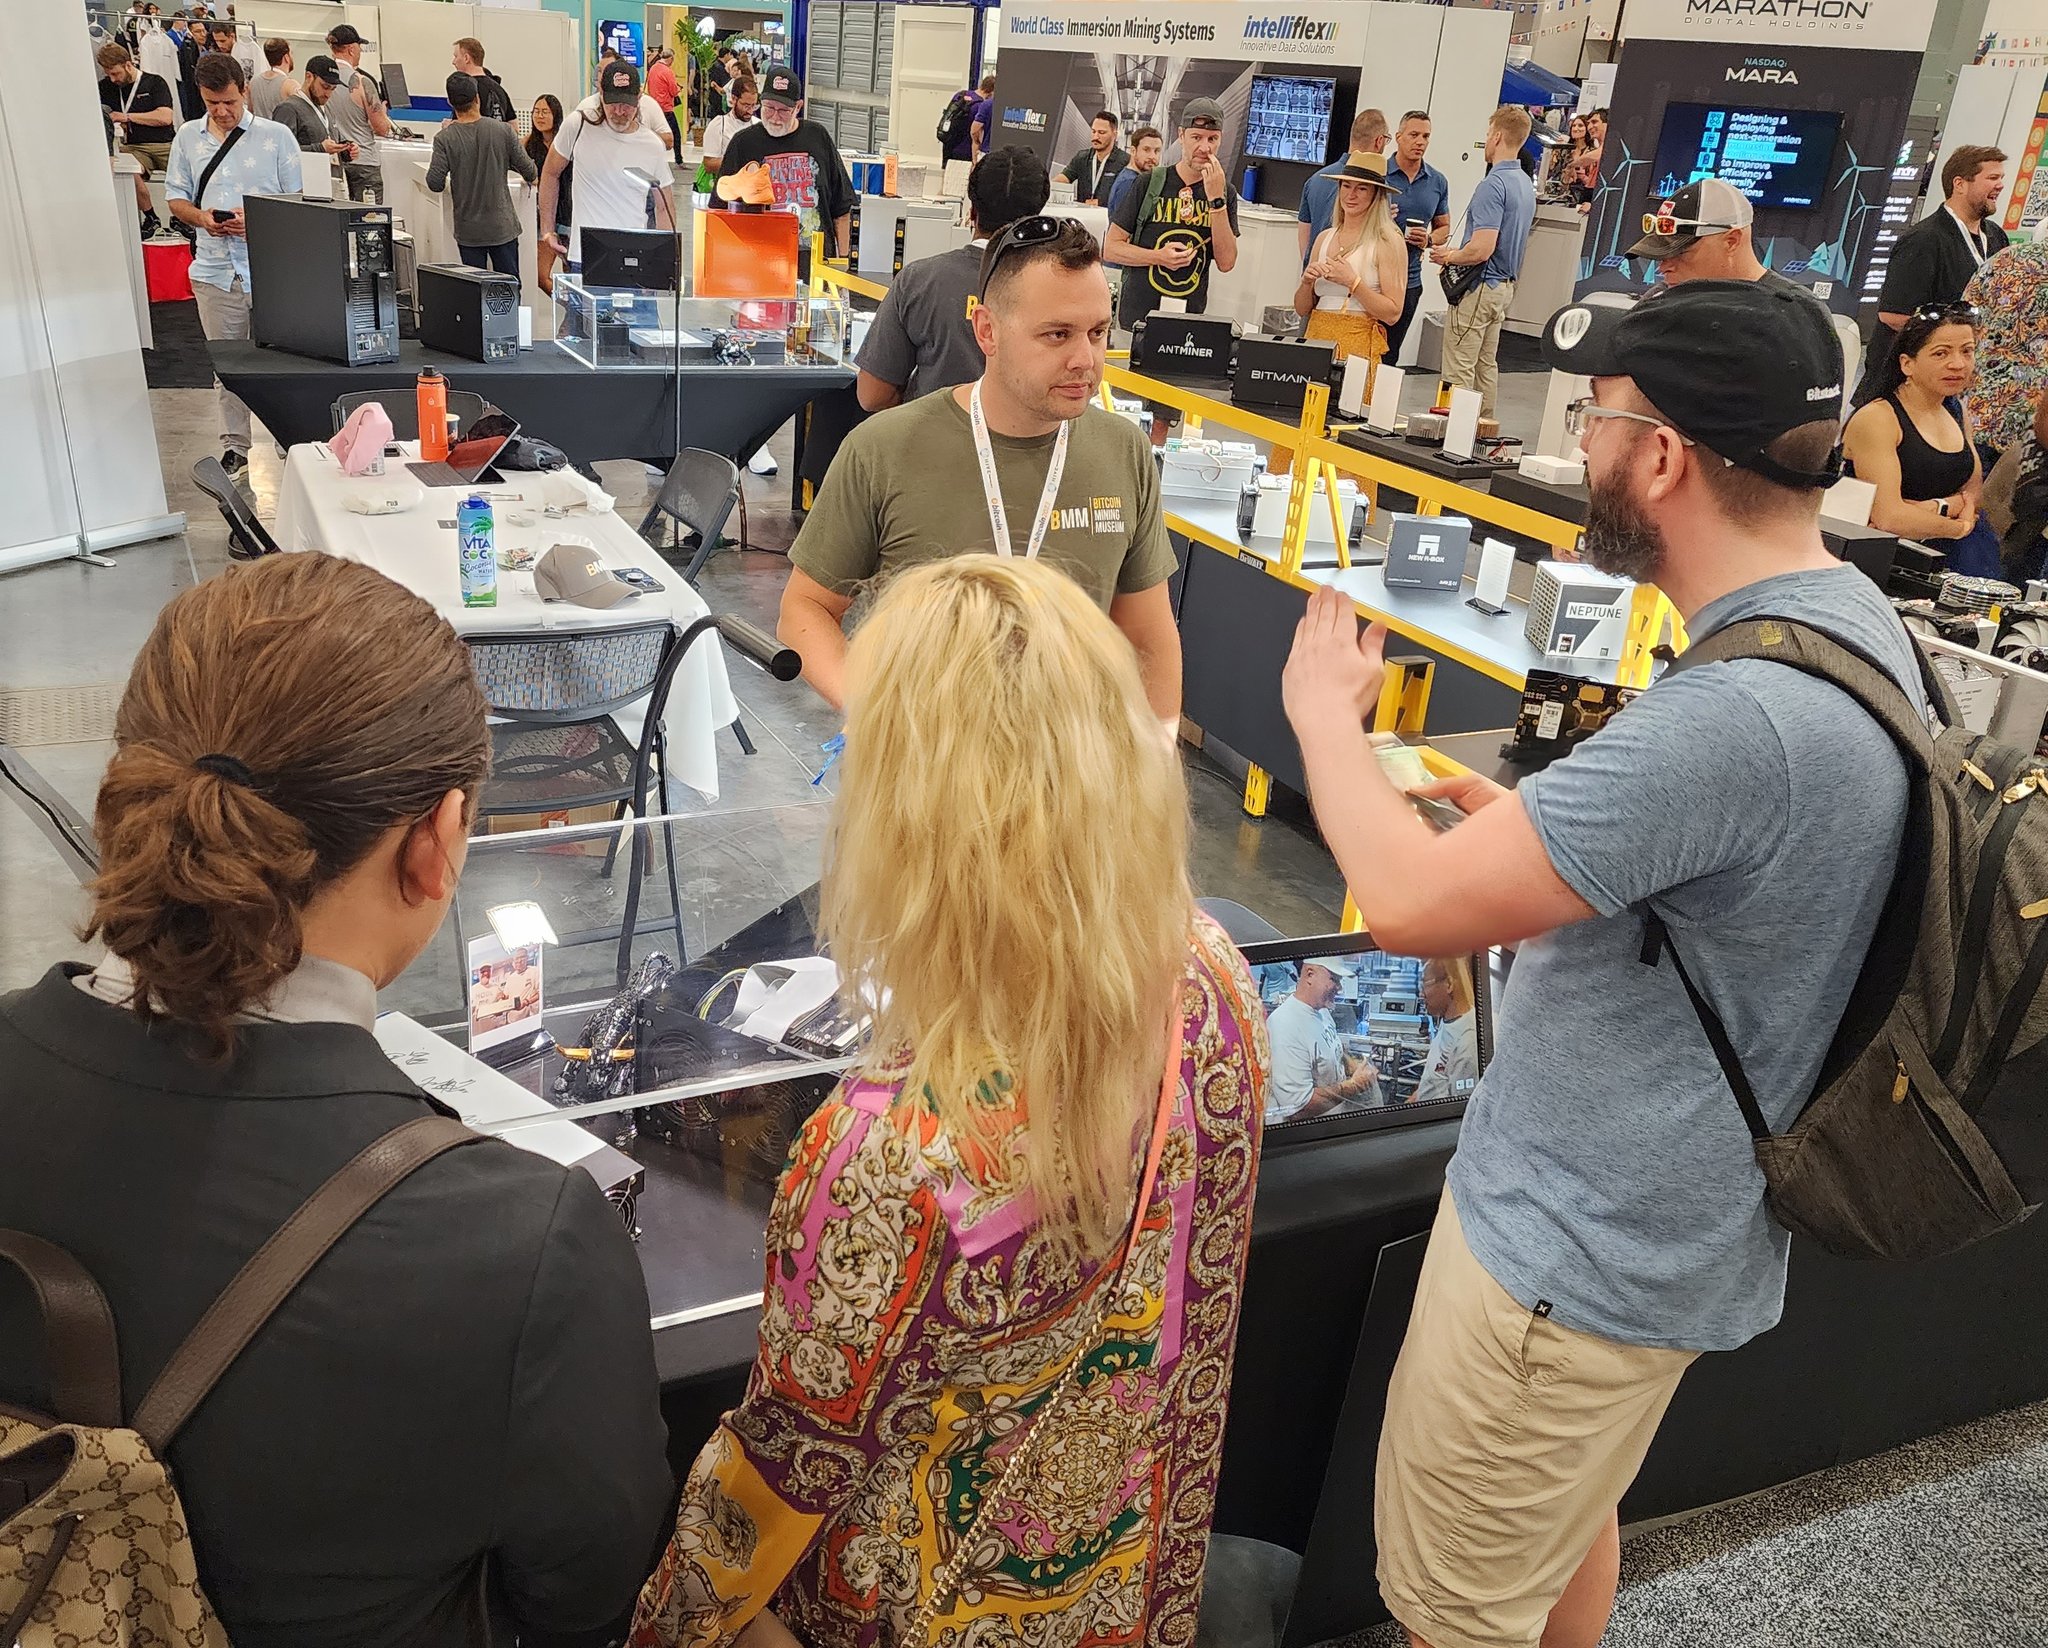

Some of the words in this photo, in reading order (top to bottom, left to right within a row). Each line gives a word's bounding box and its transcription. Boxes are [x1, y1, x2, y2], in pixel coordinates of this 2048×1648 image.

[1243, 15, 1326, 40] intelliflex
[1684, 17, 1756, 26] DIGITAL
[1769, 20, 1864, 30] HOLDINGS
[1011, 16, 1038, 35] World
[1040, 17, 1064, 35] Class
[1067, 18, 1121, 39] Immersion
[1123, 19, 1161, 43] Mining
[1164, 20, 1215, 44] Systems
[1240, 40, 1277, 52] Innovative
[1278, 42, 1297, 52] Data
[1299, 44, 1336, 55] Solutions
[1744, 57, 1788, 67] NASDAQ:
[1724, 67, 1799, 84] MARA
[1731, 113, 1779, 125] Designing
[1780, 116, 1788, 124] &
[1729, 123, 1776, 134] deploying
[1727, 132, 1802, 144] next-generation
[1732, 160, 1771, 170] improve
[1719, 168, 1764, 180] efficiency
[1765, 171, 1772, 179] &
[772, 181, 815, 203] BTC
[1157, 344, 1213, 358] ANTMINER
[1251, 370, 1311, 383] BITMAIN
[1093, 497, 1121, 509] BITCOIN
[1050, 507, 1089, 531] BMM
[1094, 509, 1120, 520] MINING
[1095, 521, 1125, 533] MUSEUM
[463, 537, 491, 549] VITA
[1569, 605, 1622, 618] NEPTUNE
